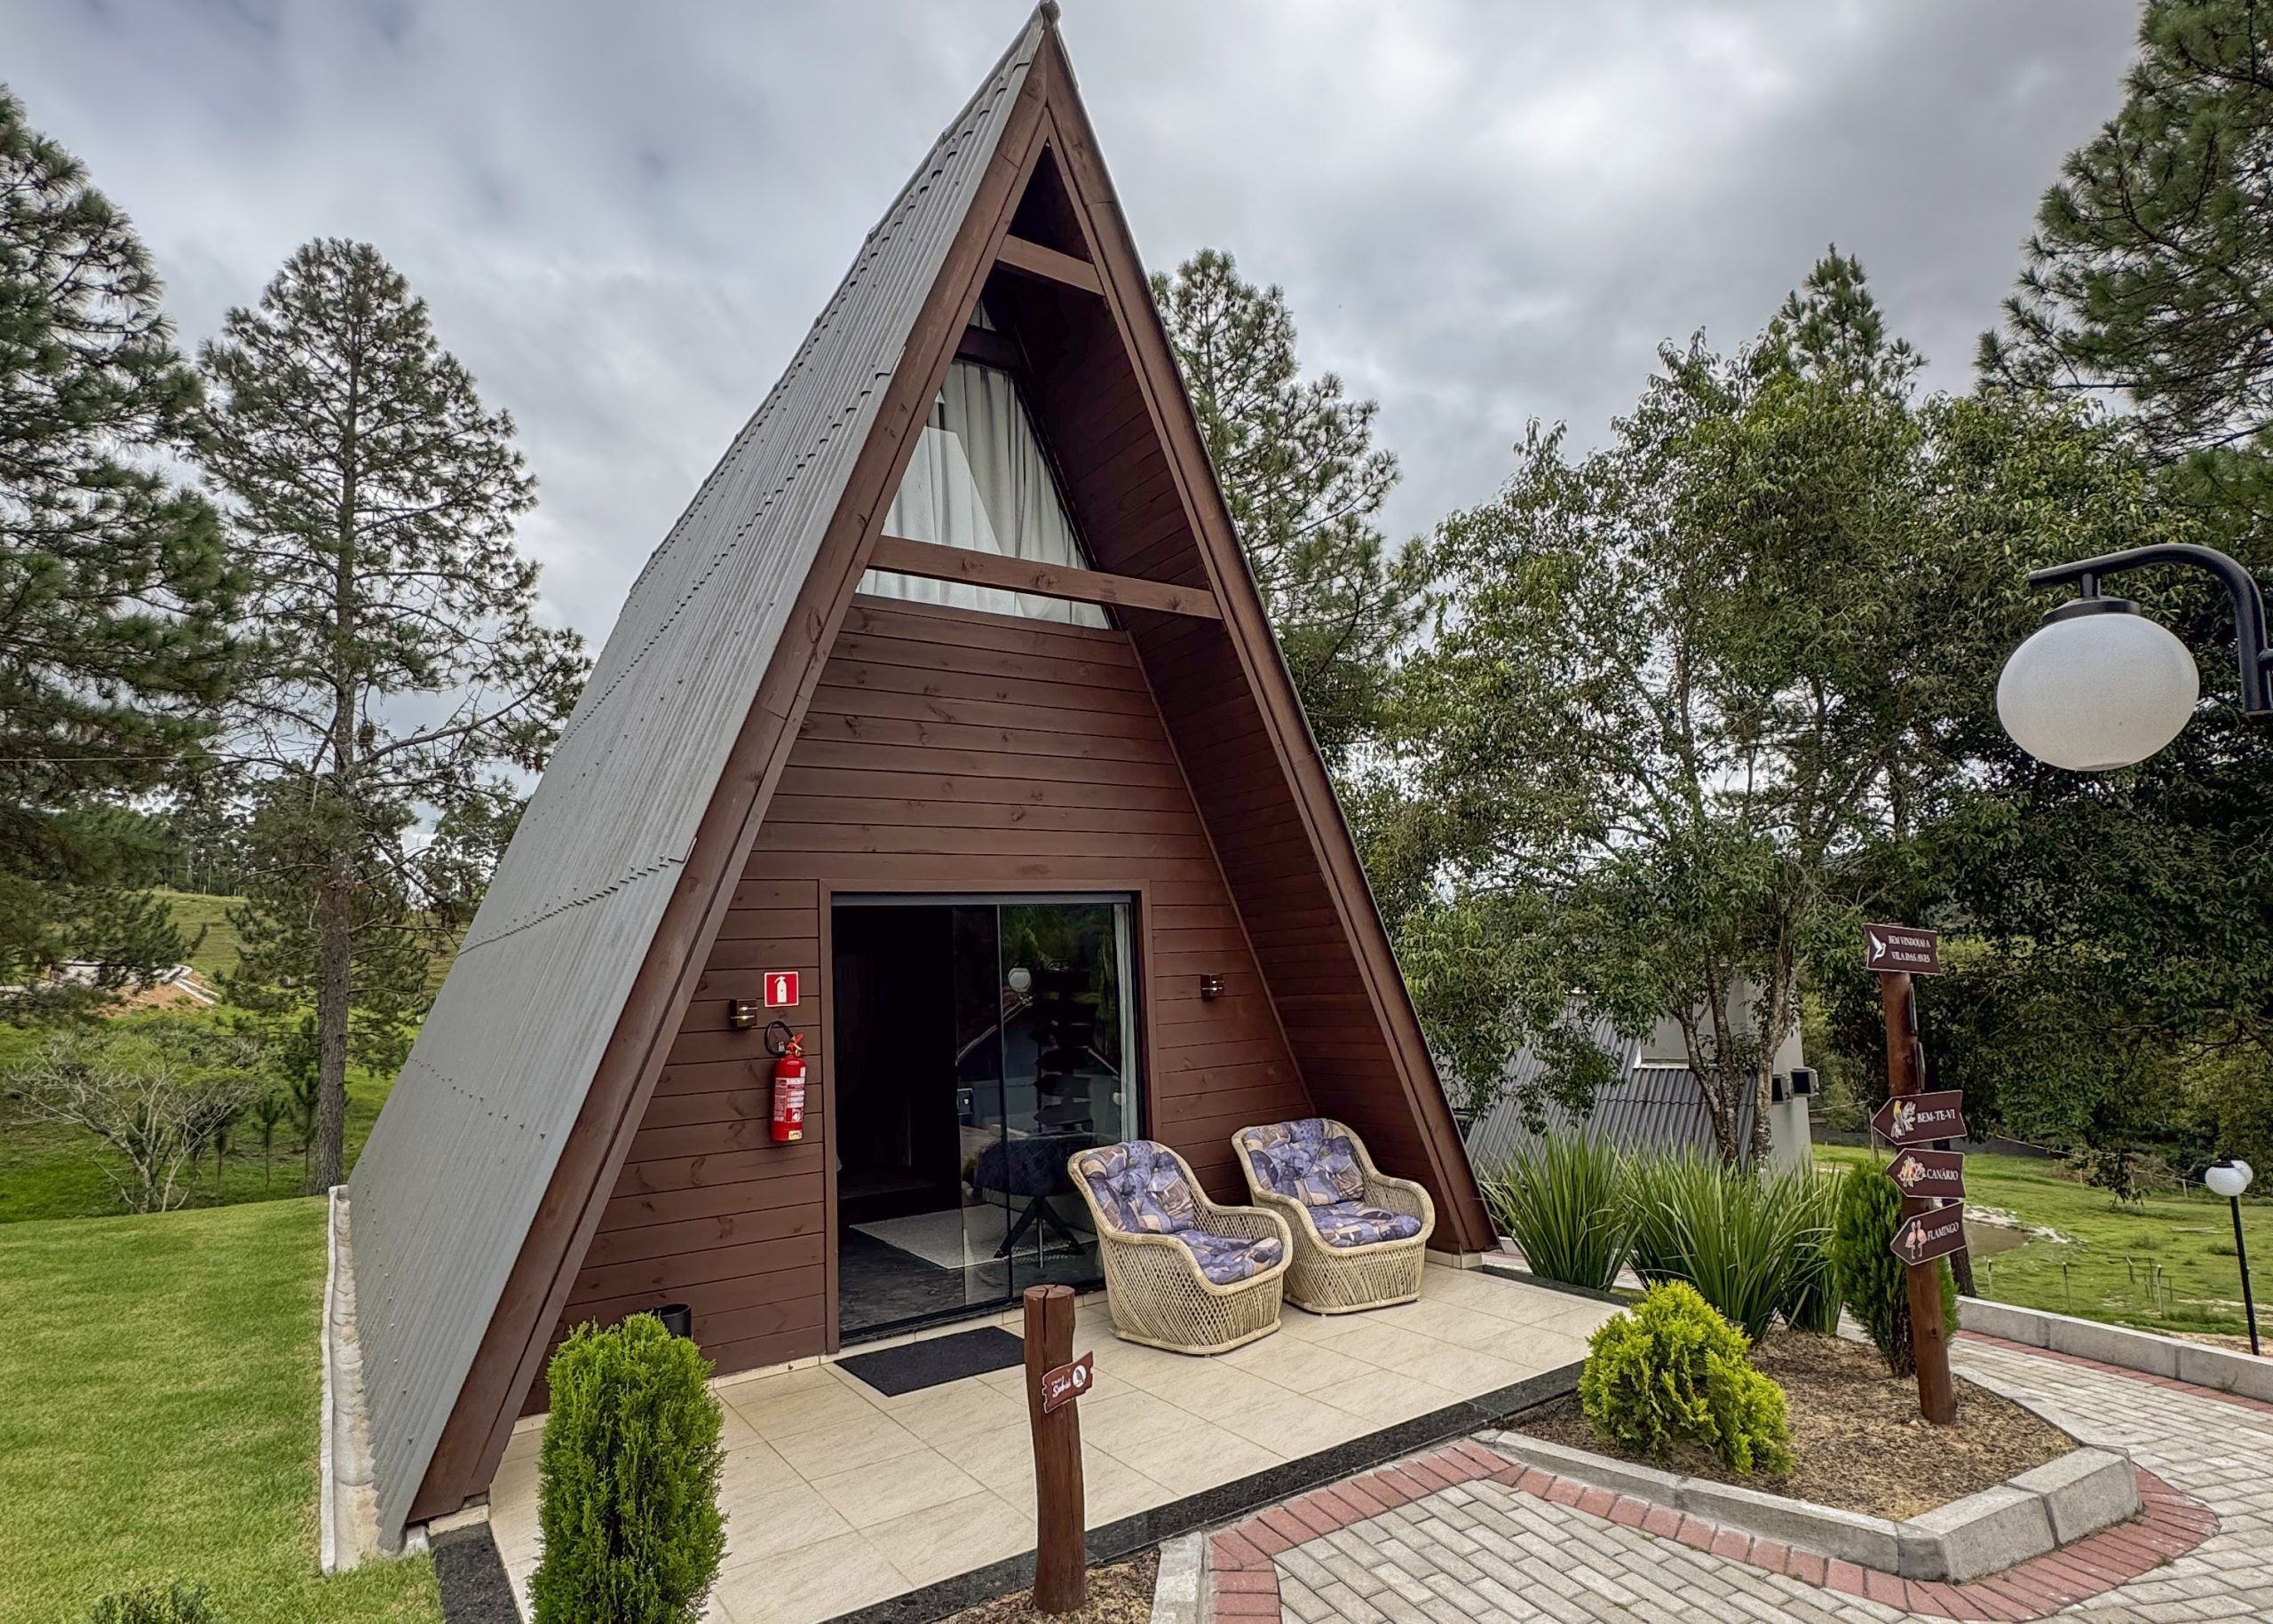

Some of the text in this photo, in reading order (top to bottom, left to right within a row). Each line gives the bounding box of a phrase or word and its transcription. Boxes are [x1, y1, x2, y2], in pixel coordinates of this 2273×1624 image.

[1917, 1109, 1956, 1123] BEM-TE-VI
[1927, 1168, 1958, 1181] CANÁRIO
[1927, 1221, 1960, 1241] FLAMINGO
